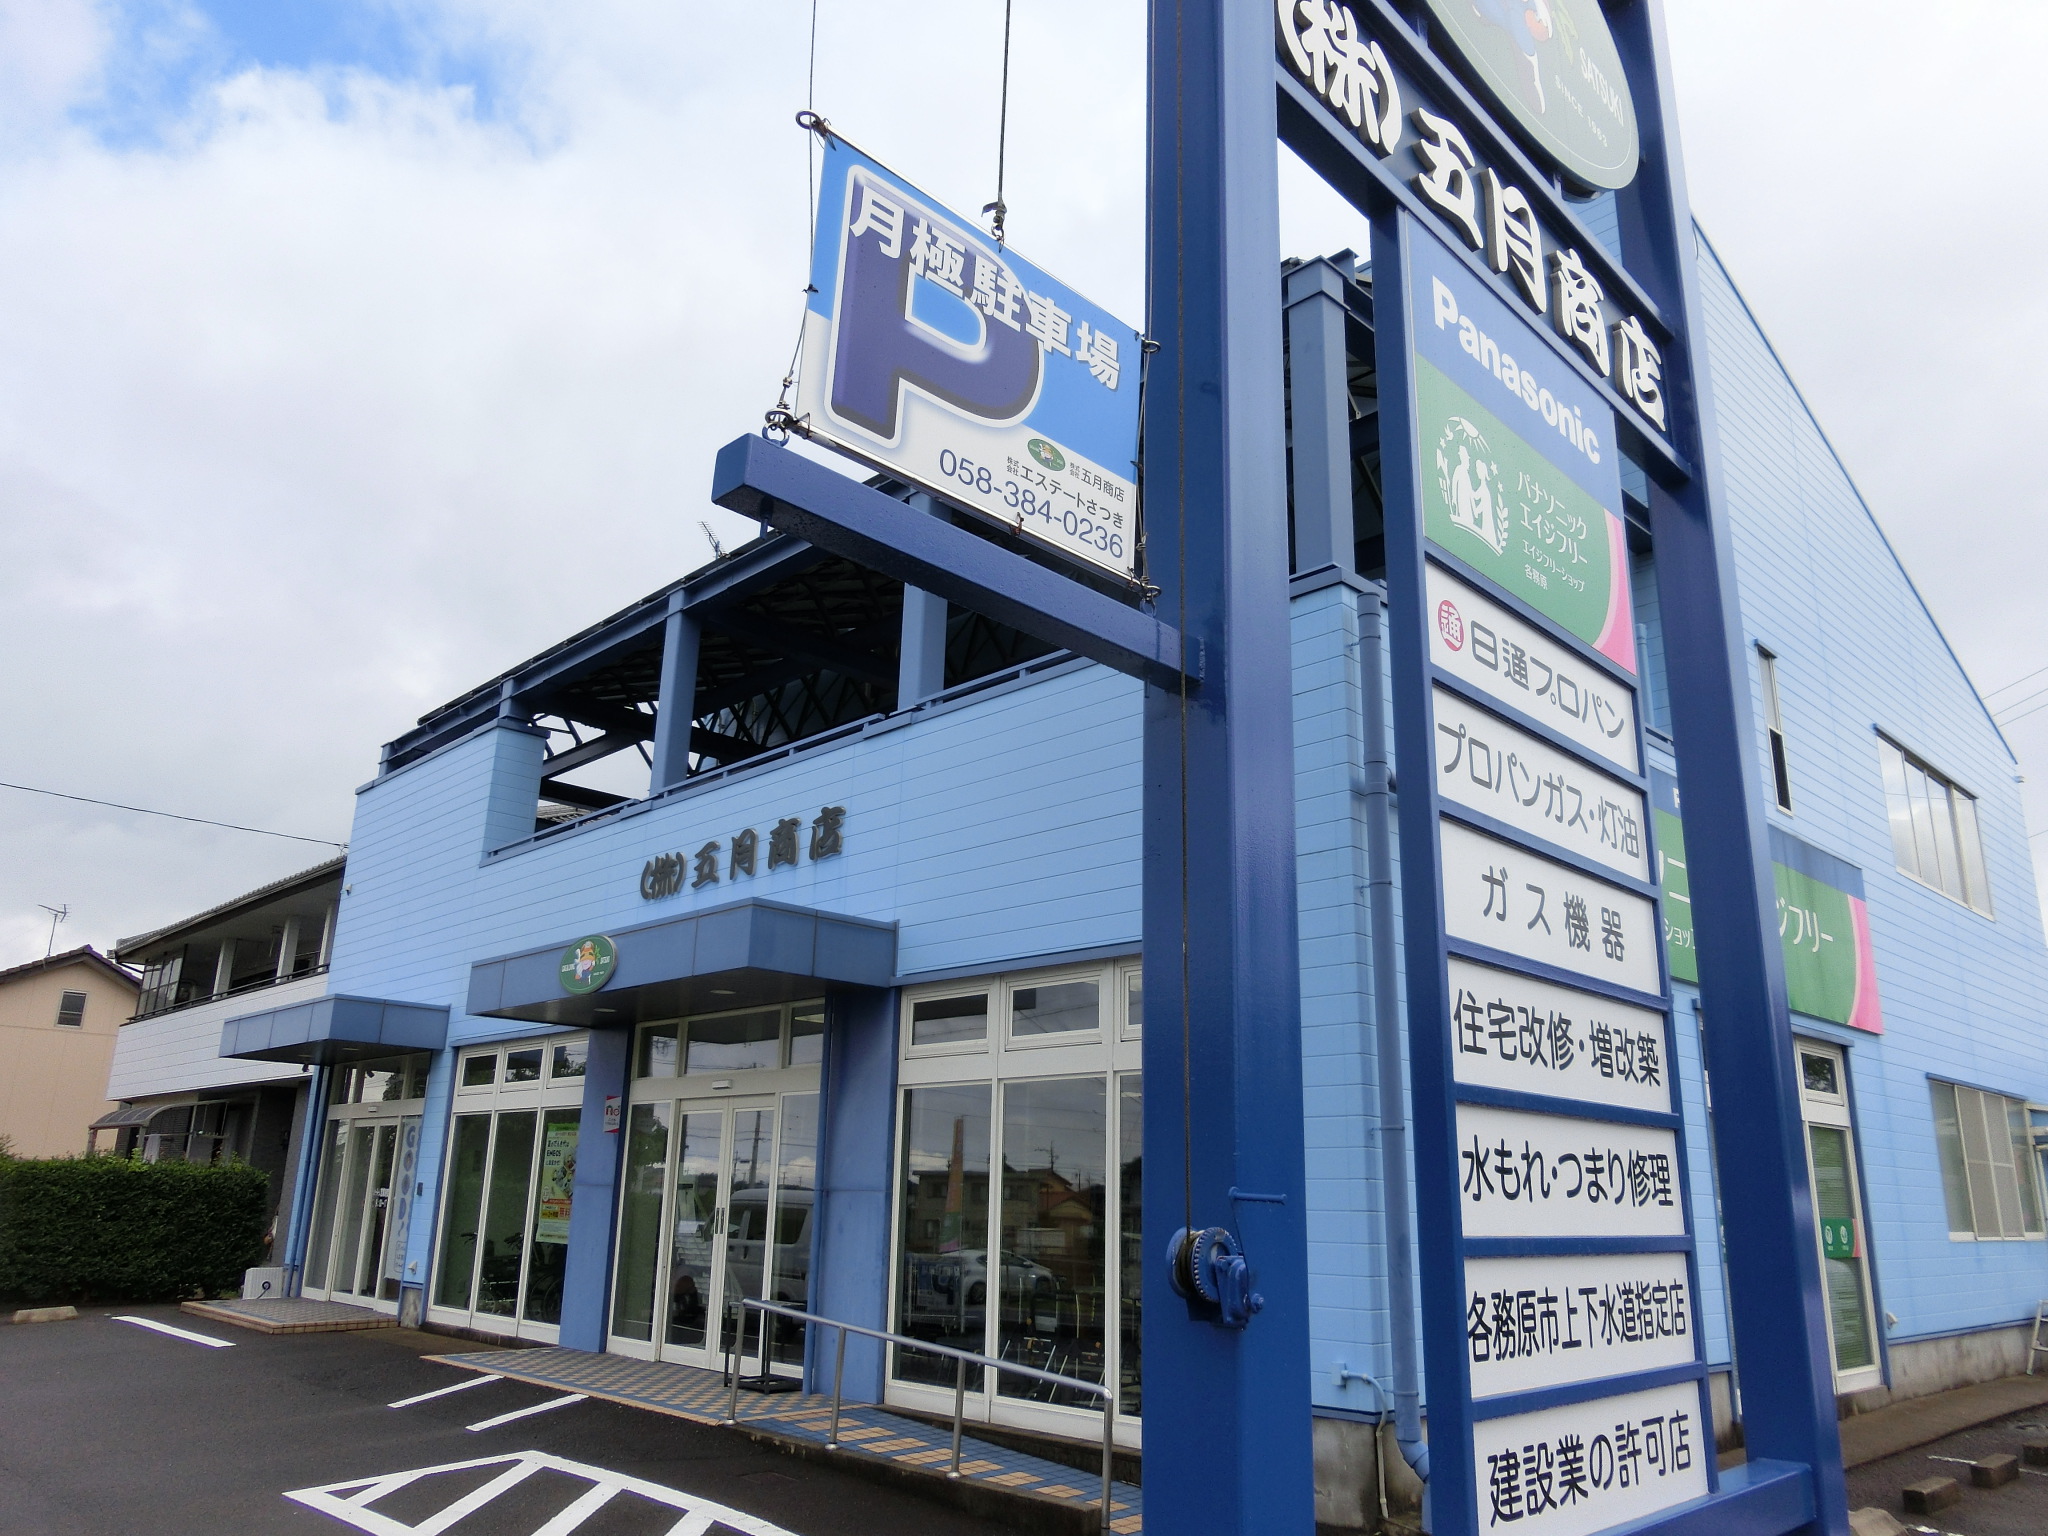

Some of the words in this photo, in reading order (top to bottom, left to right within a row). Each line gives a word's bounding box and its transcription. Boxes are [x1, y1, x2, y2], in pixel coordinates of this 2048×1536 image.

[1554, 74, 1584, 118] SINCE
[1580, 47, 1623, 127] SATSUKI
[826, 164, 1044, 449] P
[850, 186, 1121, 392] 月極駐車場
[1432, 274, 1601, 465] Panasonic
[940, 449, 1124, 560] 058-384-0236
[1020, 465, 1124, 529] エステートさつき
[1081, 467, 1126, 503] 五月商店
[1517, 471, 1587, 540] パナソニック
[1519, 502, 1588, 564] エイジフリー
[1522, 539, 1586, 592] エイジフリーショップ
[1524, 563, 1549, 590] 各務原
[1470, 620, 1625, 739] 日通プロパン
[1437, 721, 1641, 859] プロパンガス・灯油
[1481, 865, 1625, 962] ガス機器
[1453, 988, 1661, 1087] 住宅改修・増改築
[1462, 1134, 1674, 1207] 水もれ・つまり修理
[1467, 1278, 1686, 1363] 各務原市上下水道指定店
[1488, 1409, 1691, 1528] 建設業の許可店
